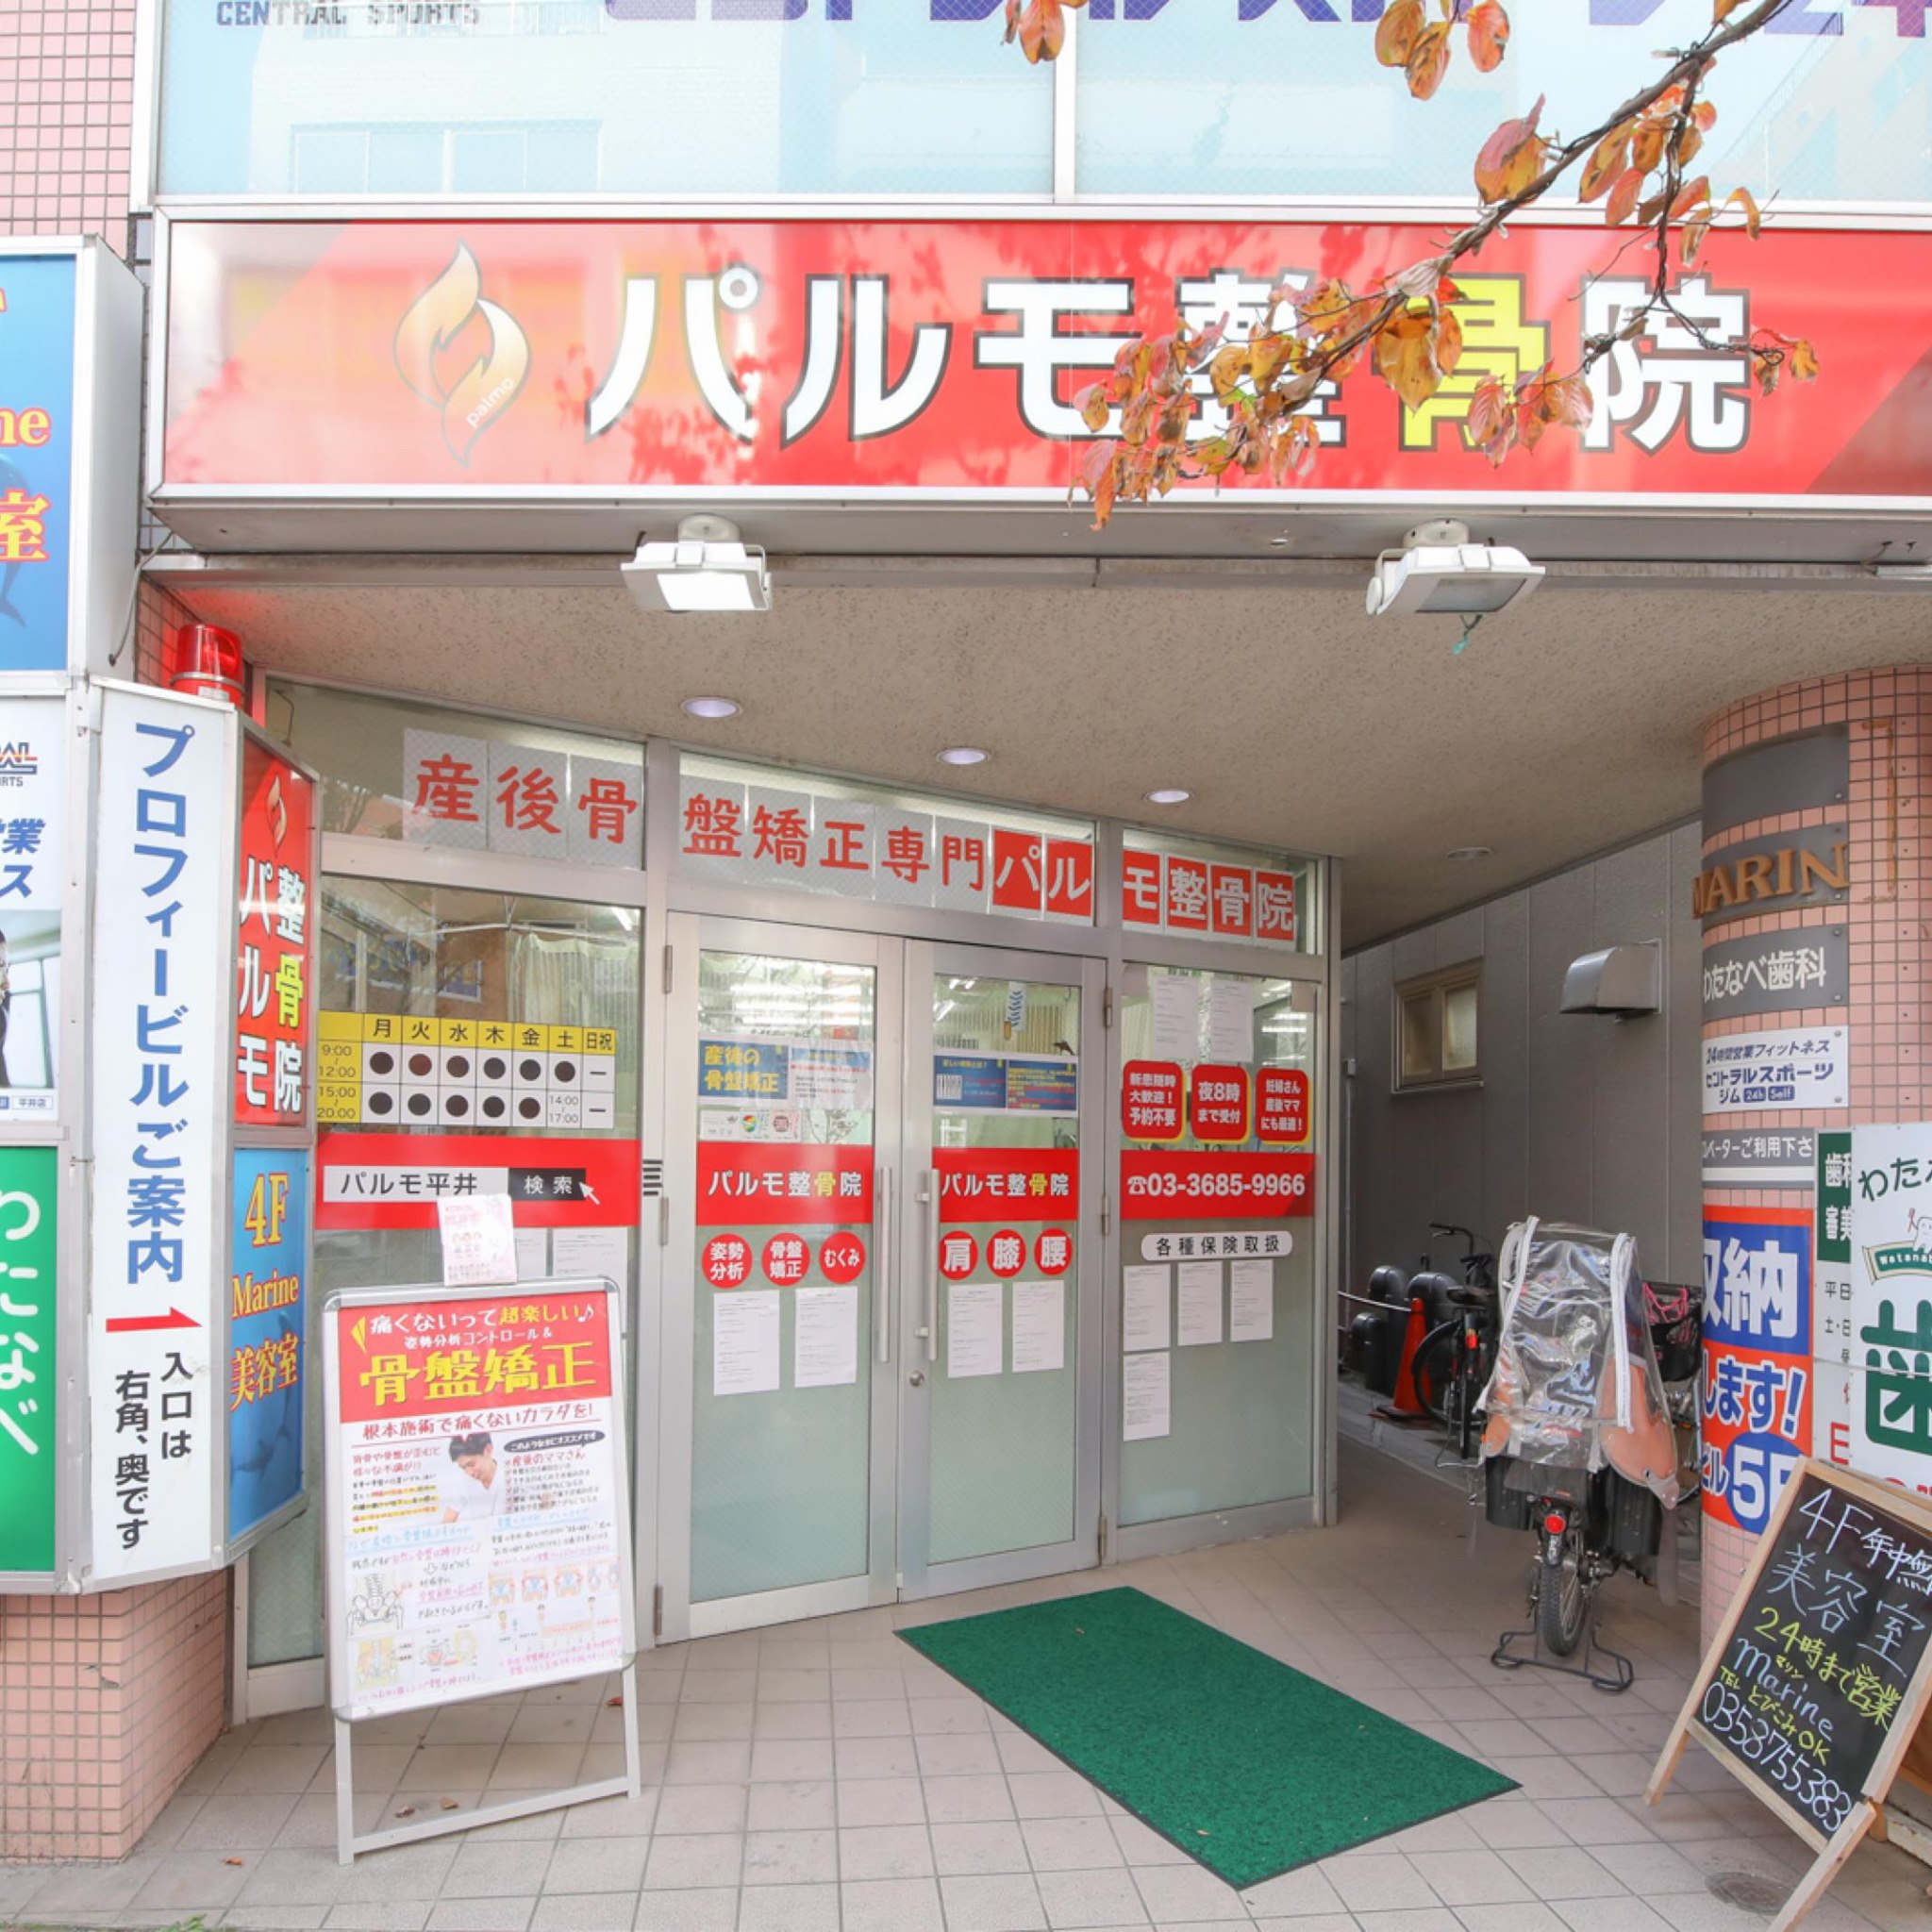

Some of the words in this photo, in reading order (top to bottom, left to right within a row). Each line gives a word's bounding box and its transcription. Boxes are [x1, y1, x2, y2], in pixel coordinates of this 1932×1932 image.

[216, 1, 346, 25] CENTRAL
[466, 377, 515, 429] palmo
[0, 776, 24, 787] RTS
[0, 818, 46, 855] 業
[238, 856, 274, 1108] パルモ
[1704, 946, 1827, 1004] わたなべ歯科
[274, 865, 307, 1114] 整骨院
[127, 722, 196, 1285] プロフィービルご案内
[373, 1019, 392, 1038] 月
[410, 1022, 431, 1040] 火
[448, 1024, 469, 1041] 水
[485, 1026, 505, 1043] 木
[522, 1028, 541, 1046] 金
[556, 1031, 575, 1048] 土
[586, 1032, 613, 1051] 日祝
[322, 1045, 352, 1057] 9:00
[318, 1066, 356, 1079] 12:00
[1706, 1062, 1835, 1089] セントラルスポーツ
[318, 1086, 356, 1098] 15:00
[549, 1095, 578, 1106] 14:00
[1197, 1081, 1241, 1102] 夜8時
[317, 1108, 356, 1120] 20:00
[549, 1113, 578, 1124] 17:00
[1197, 1109, 1241, 1124] まで受付
[340, 1172, 478, 1196] パルモ平井
[524, 1174, 574, 1196] 検索
[708, 1169, 862, 1197] パルモ整骨院
[941, 1173, 1069, 1196] パルモ整骨院
[1147, 1172, 1306, 1197] 03-3685-9966
[243, 1172, 289, 1248] 4F
[710, 1241, 744, 1261] 姿勢
[770, 1241, 803, 1259] 骨盤
[824, 1247, 860, 1268] むくみ
[943, 1238, 973, 1272] 肩
[992, 1237, 1020, 1270] 膝
[1040, 1236, 1067, 1267] 腰
[1156, 1233, 1281, 1257] 各種保険取扱
[710, 1261, 744, 1281] 分析
[770, 1260, 803, 1279] 矯正
[1879, 1253, 1932, 1265] Watana
[231, 1271, 299, 1320] Marine
[229, 1331, 300, 1412] 美容室
[359, 1341, 598, 1407] 骨盤矯正
[160, 1351, 193, 1461] 入口は
[114, 1370, 151, 1551] 右角、奥です
[1800, 1489, 1874, 1555] 4F
[1860, 1527, 1932, 1596] 年中無
[1766, 1542, 1925, 1678] 美容室
[1720, 1665, 1741, 1690] TEL
[1753, 1607, 1903, 1732] 24時まで営業
